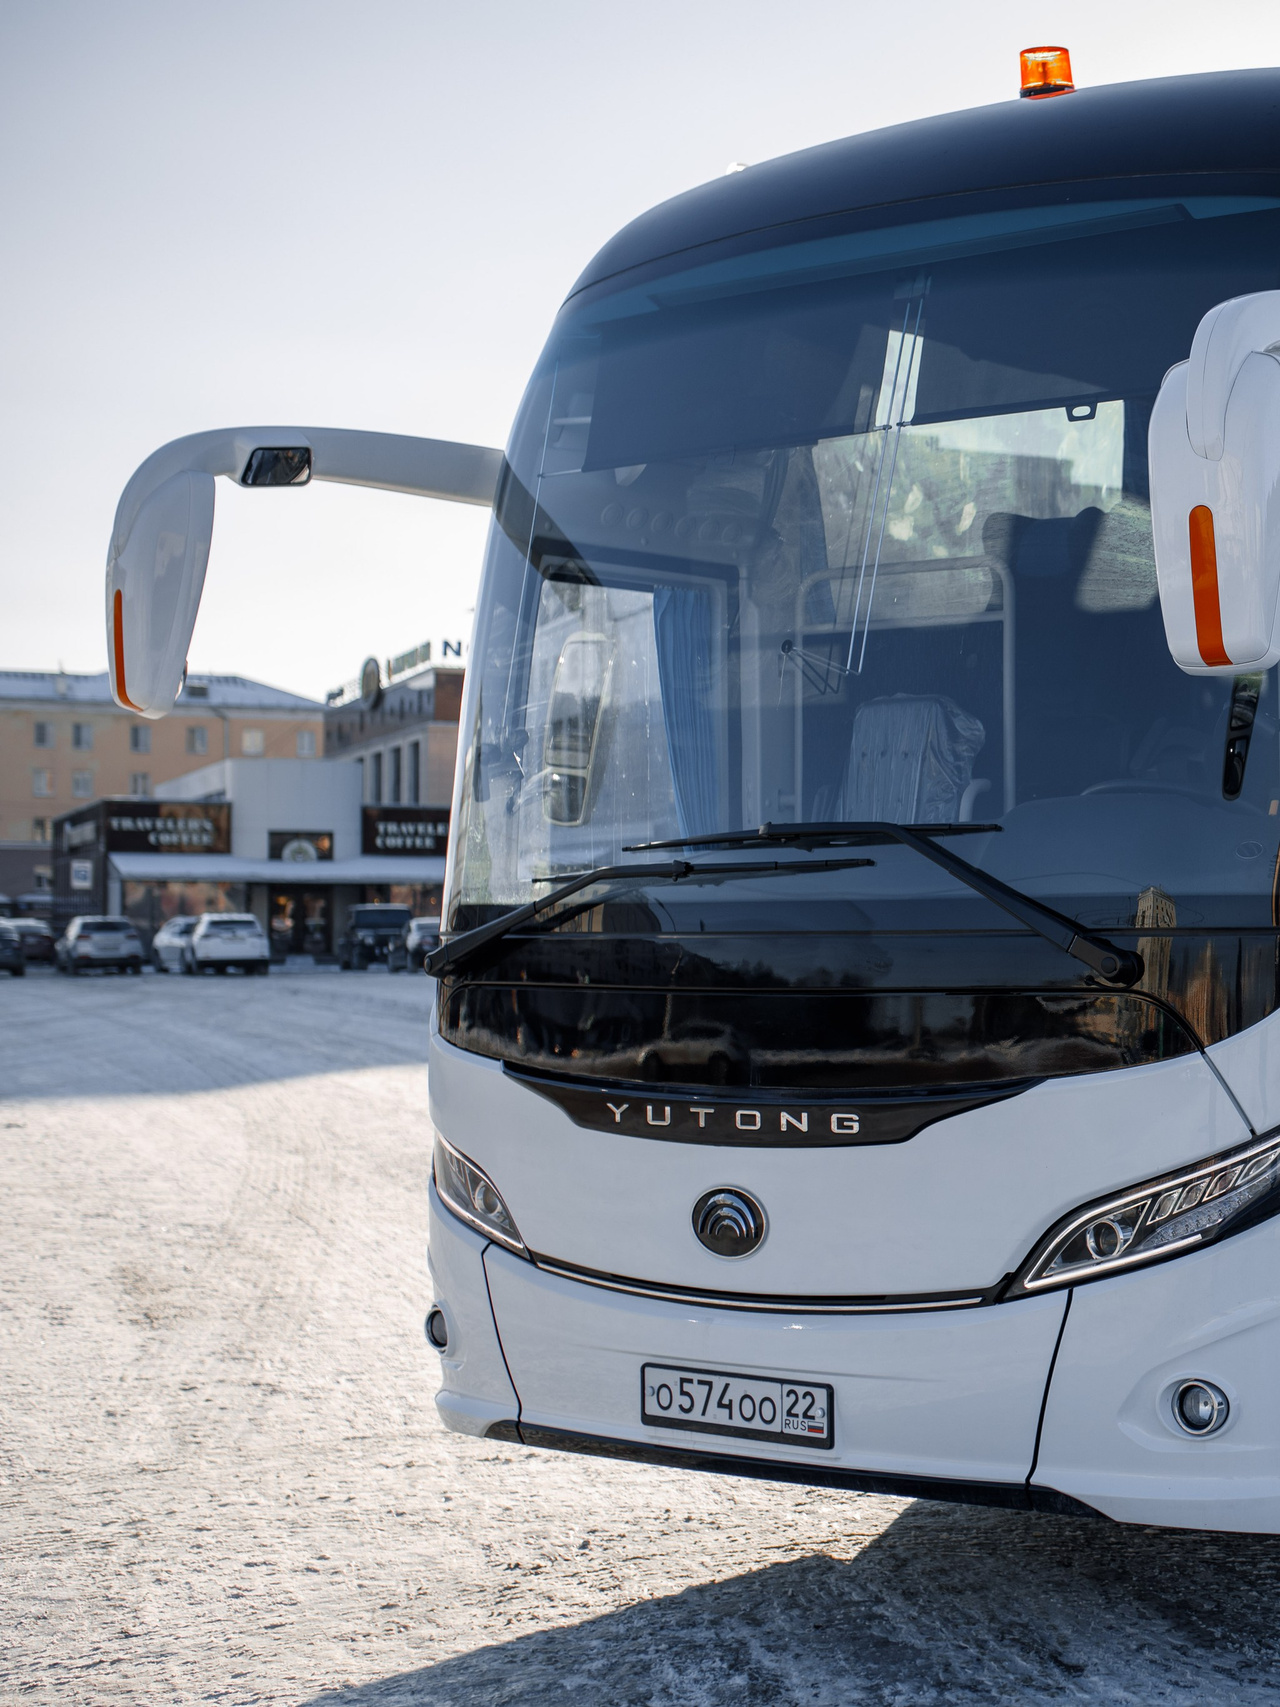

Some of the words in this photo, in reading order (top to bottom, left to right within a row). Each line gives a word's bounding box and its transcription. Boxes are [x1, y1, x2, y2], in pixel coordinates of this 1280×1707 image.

[376, 821, 449, 837] TRAVELE
[606, 1102, 860, 1134] YUTONG
[786, 1388, 816, 1421] 22
[784, 1418, 807, 1431] RUS
